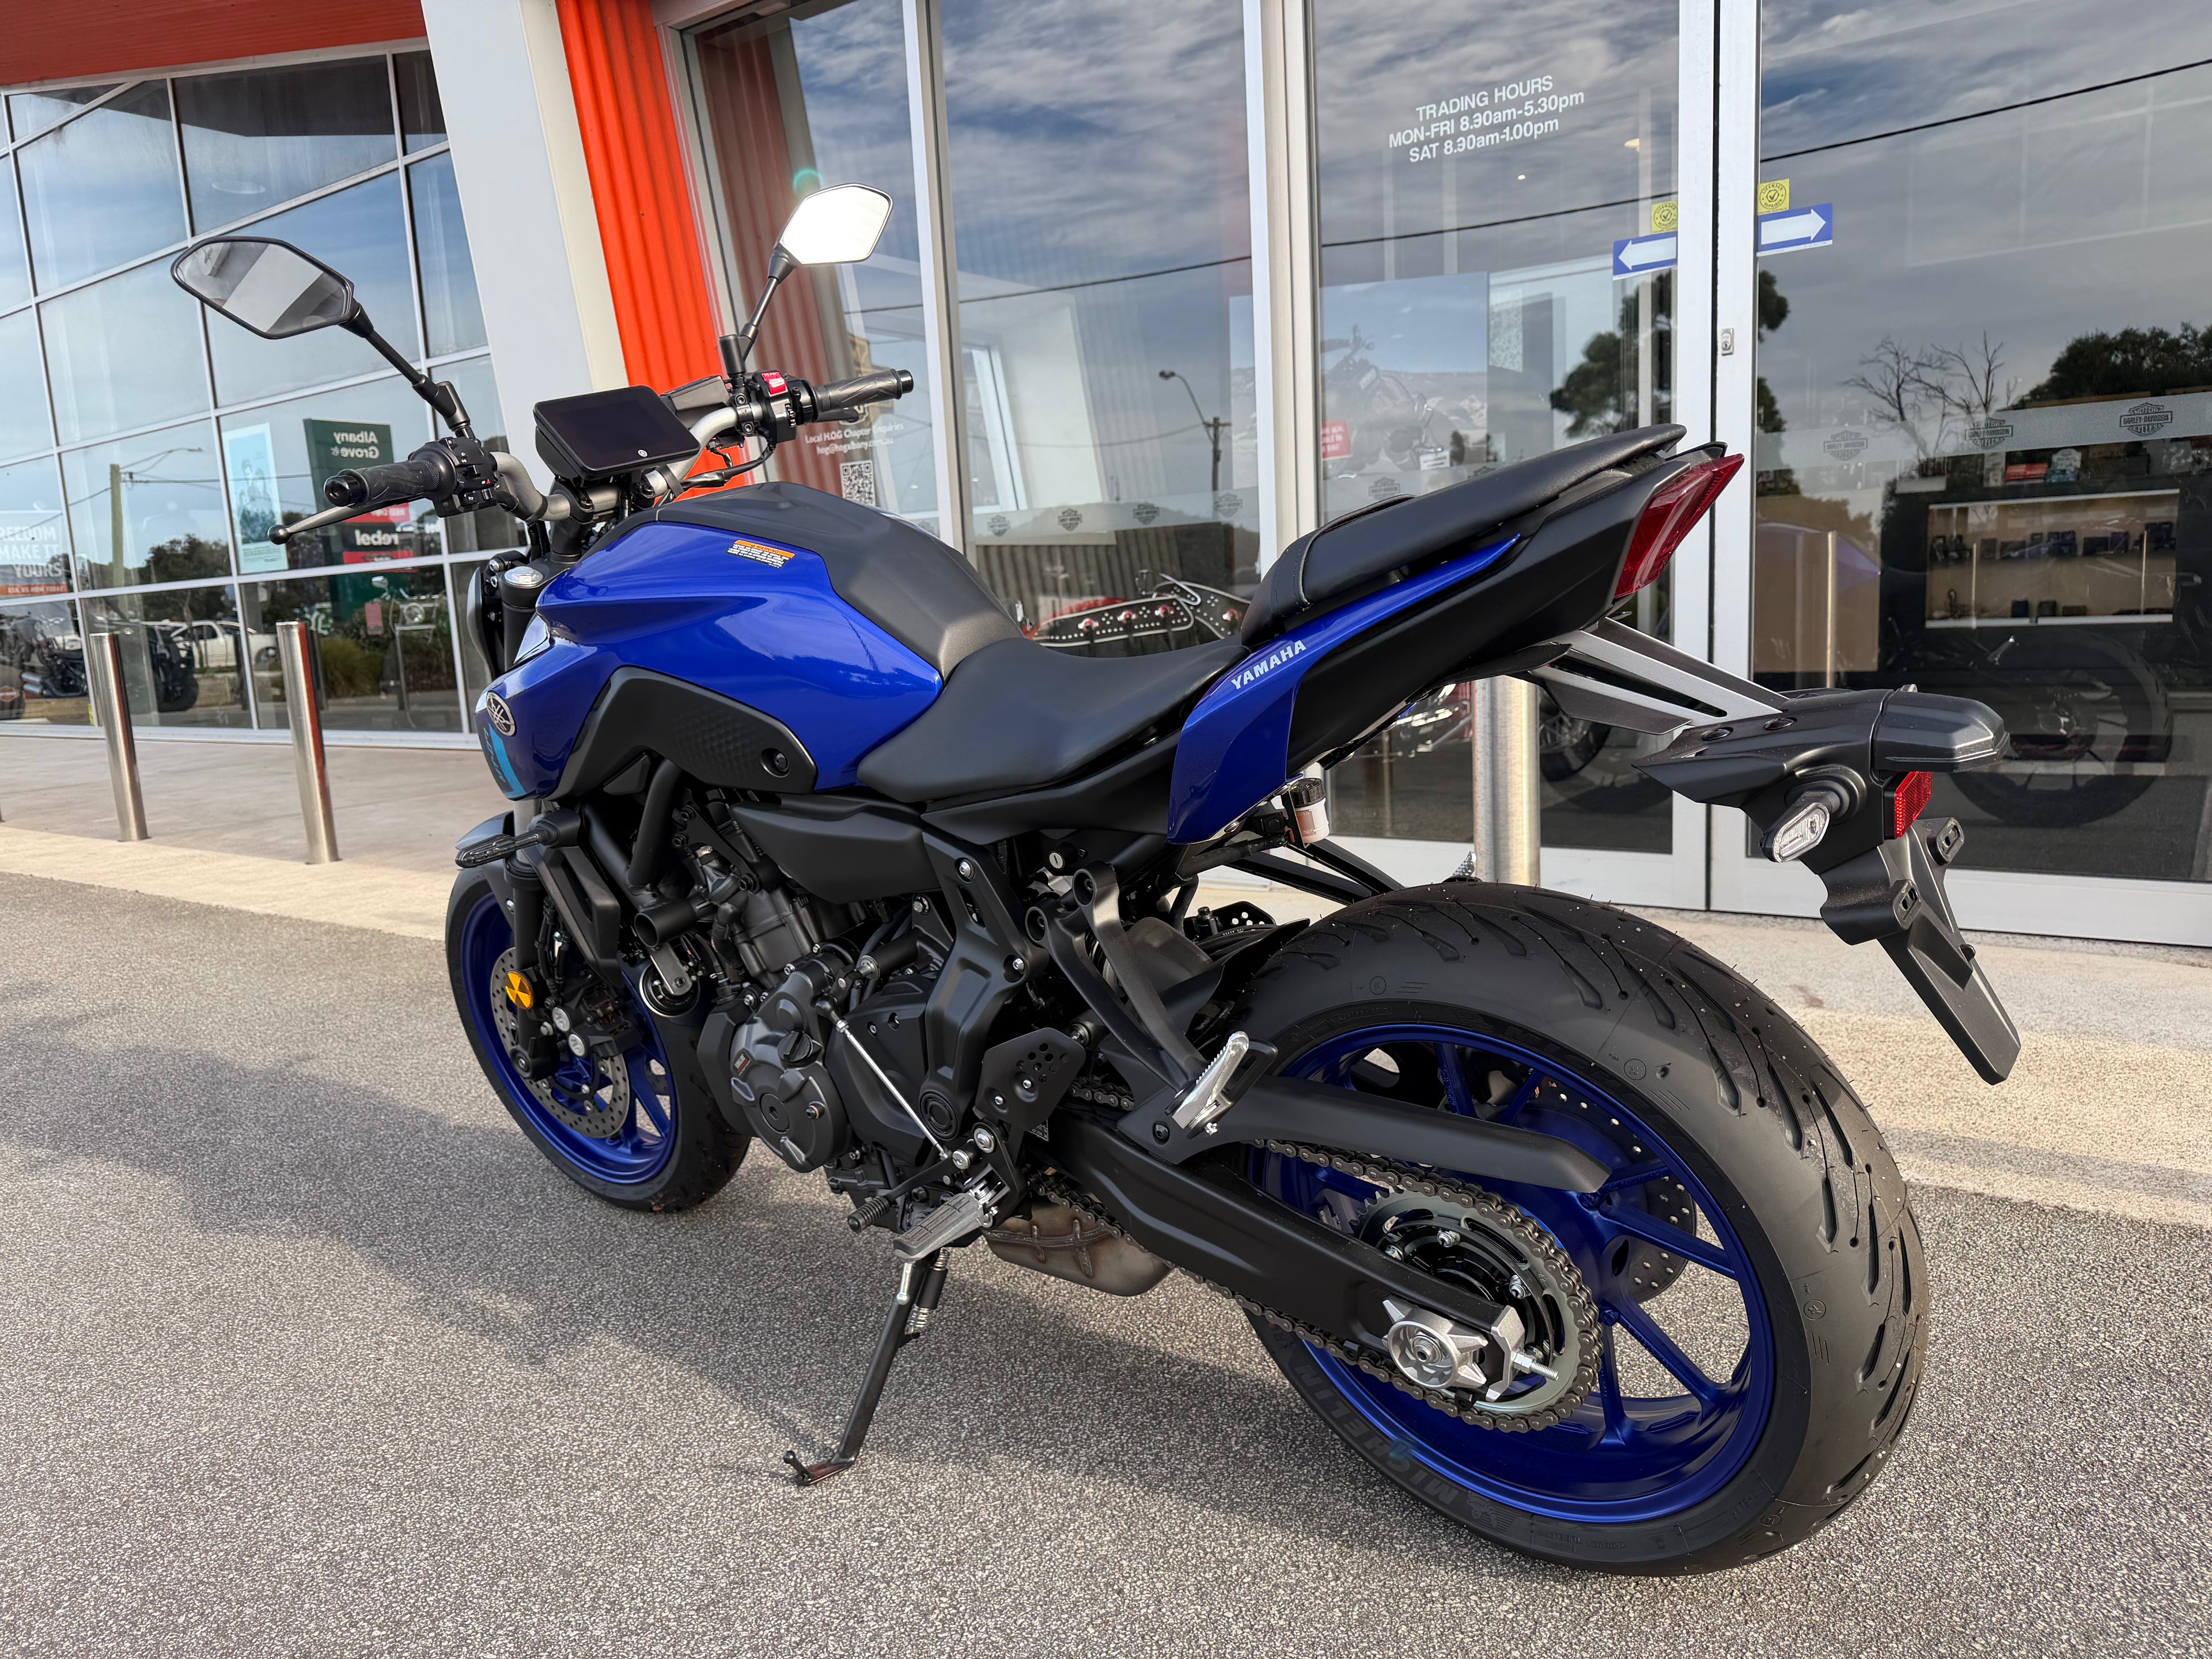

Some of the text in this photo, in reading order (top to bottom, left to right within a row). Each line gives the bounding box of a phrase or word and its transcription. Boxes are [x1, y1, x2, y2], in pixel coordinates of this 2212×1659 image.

[1389, 91, 1585, 147] MON-FRI 8.30am-5.30pm
[1416, 75, 1553, 121] TRADING HOURS
[1410, 118, 1559, 162] SAT 8.30am-1.00pm
[805, 433, 823, 444] Local
[843, 428, 872, 439] Chapter
[0, 543, 40, 560] MAKE
[13, 562, 63, 578] YOURS
[1231, 639, 1306, 690] YAMAHA
[1293, 1362, 1462, 1507] MICHELIN
